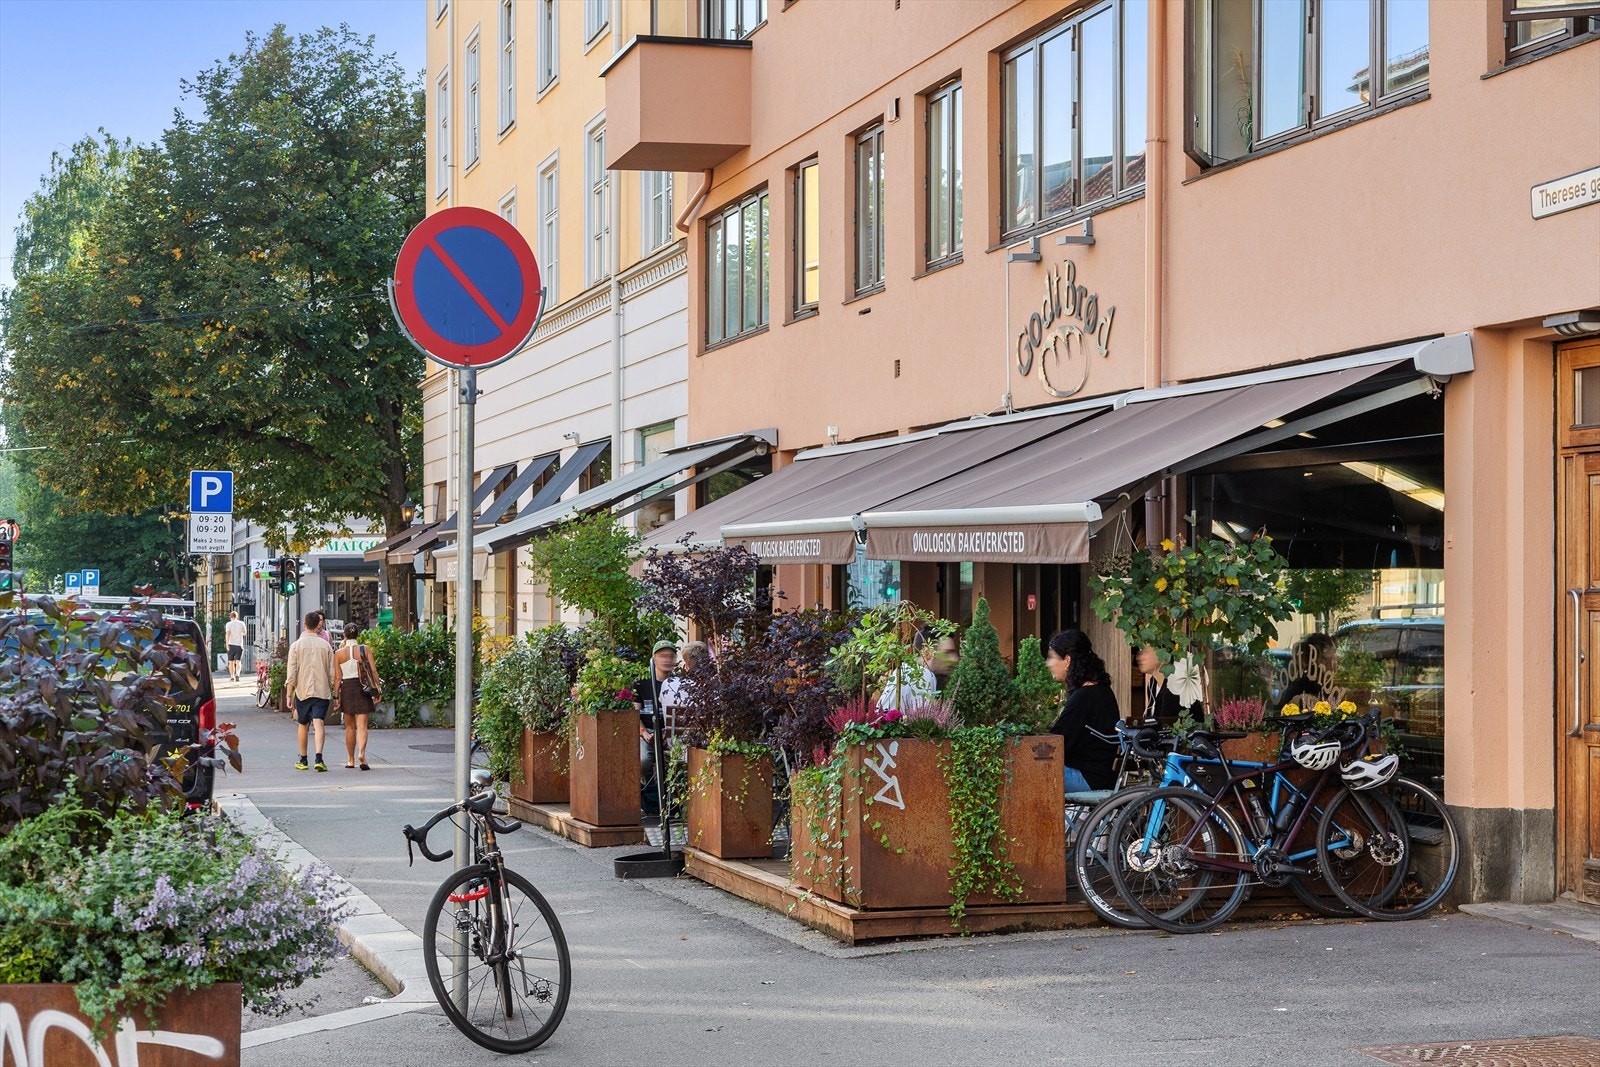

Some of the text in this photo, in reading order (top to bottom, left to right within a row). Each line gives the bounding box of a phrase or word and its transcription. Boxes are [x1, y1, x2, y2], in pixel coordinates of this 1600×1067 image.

[1538, 182, 1587, 209] Thereses
[201, 476, 223, 508] P
[750, 538, 821, 558] ØKOLOGISK BAKEVERKSTED
[912, 530, 1025, 554] ØKOLOGISK BAKEVERKSTED
[255, 561, 265, 570] 24
[69, 575, 77, 586] P
[86, 572, 95, 584] P
[175, 704, 191, 712] 701
